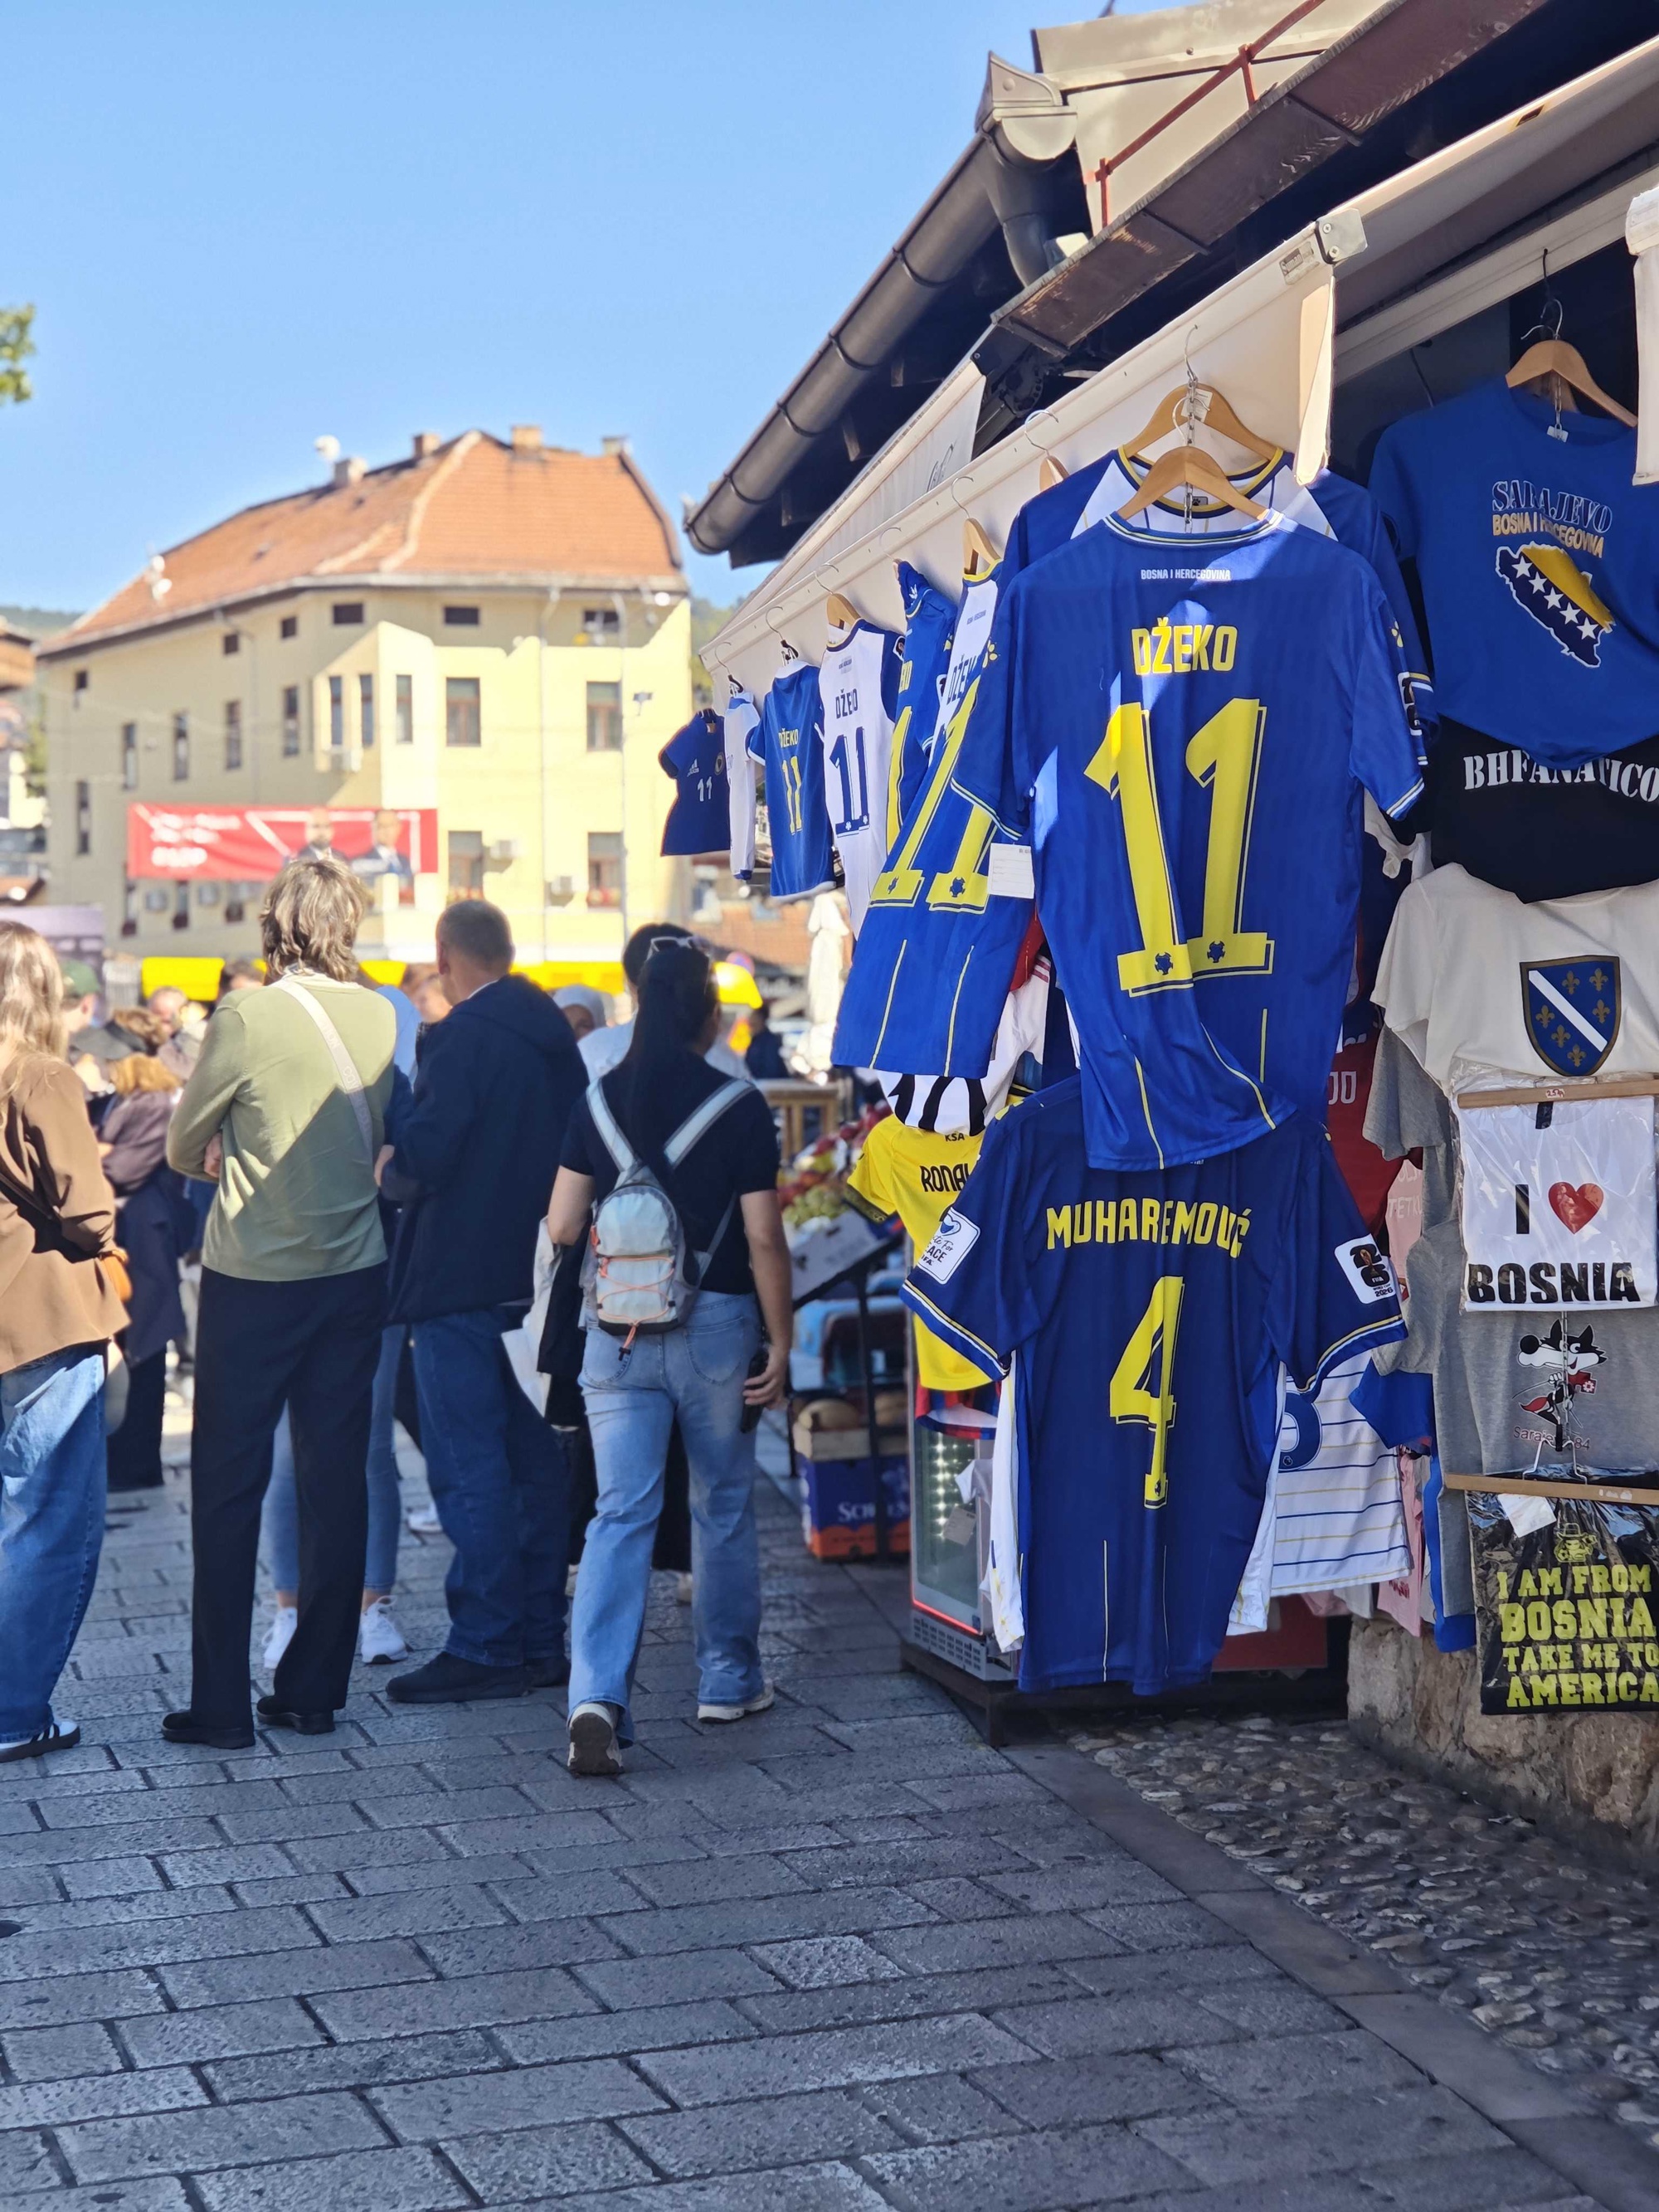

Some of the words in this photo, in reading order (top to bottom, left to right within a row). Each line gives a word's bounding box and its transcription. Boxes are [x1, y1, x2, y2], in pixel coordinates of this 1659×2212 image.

[1492, 480, 1613, 533] SARAJEVO
[1492, 512, 1531, 536] BOSNA
[1534, 511, 1537, 532] I
[1540, 513, 1604, 558] HCEGOVINA
[1141, 569, 1169, 580] BOSNA
[1170, 569, 1174, 579] I
[1175, 569, 1231, 581] HERCEGOVINA
[1131, 616, 1238, 676] DŽEKO
[835, 688, 858, 719] DŽEO
[778, 727, 799, 748] DŽEKO
[697, 776, 713, 802] 11
[782, 756, 802, 835] 11
[830, 727, 870, 839] 11
[1083, 698, 1274, 998] 11
[945, 1133, 965, 1142] KSA
[1046, 1198, 1252, 1258] MUHAREMOVĆ
[1515, 1184, 1530, 1234] I
[941, 1240, 954, 1252] For
[1374, 1286, 1394, 1297] 2026
[1467, 1262, 1641, 1304] BOSNIA
[1110, 1276, 1185, 1509] 4
[1497, 1572, 1509, 1599] I
[1518, 1567, 1564, 1597] AM
[1572, 1564, 1652, 1594] FROM
[1499, 1597, 1657, 1642] BOSNIA
[1502, 1645, 1574, 1672] TAKE
[1581, 1643, 1620, 1668] ME
[1627, 1642, 1659, 1668] TO
[1506, 1672, 1659, 1707] AMERICA
